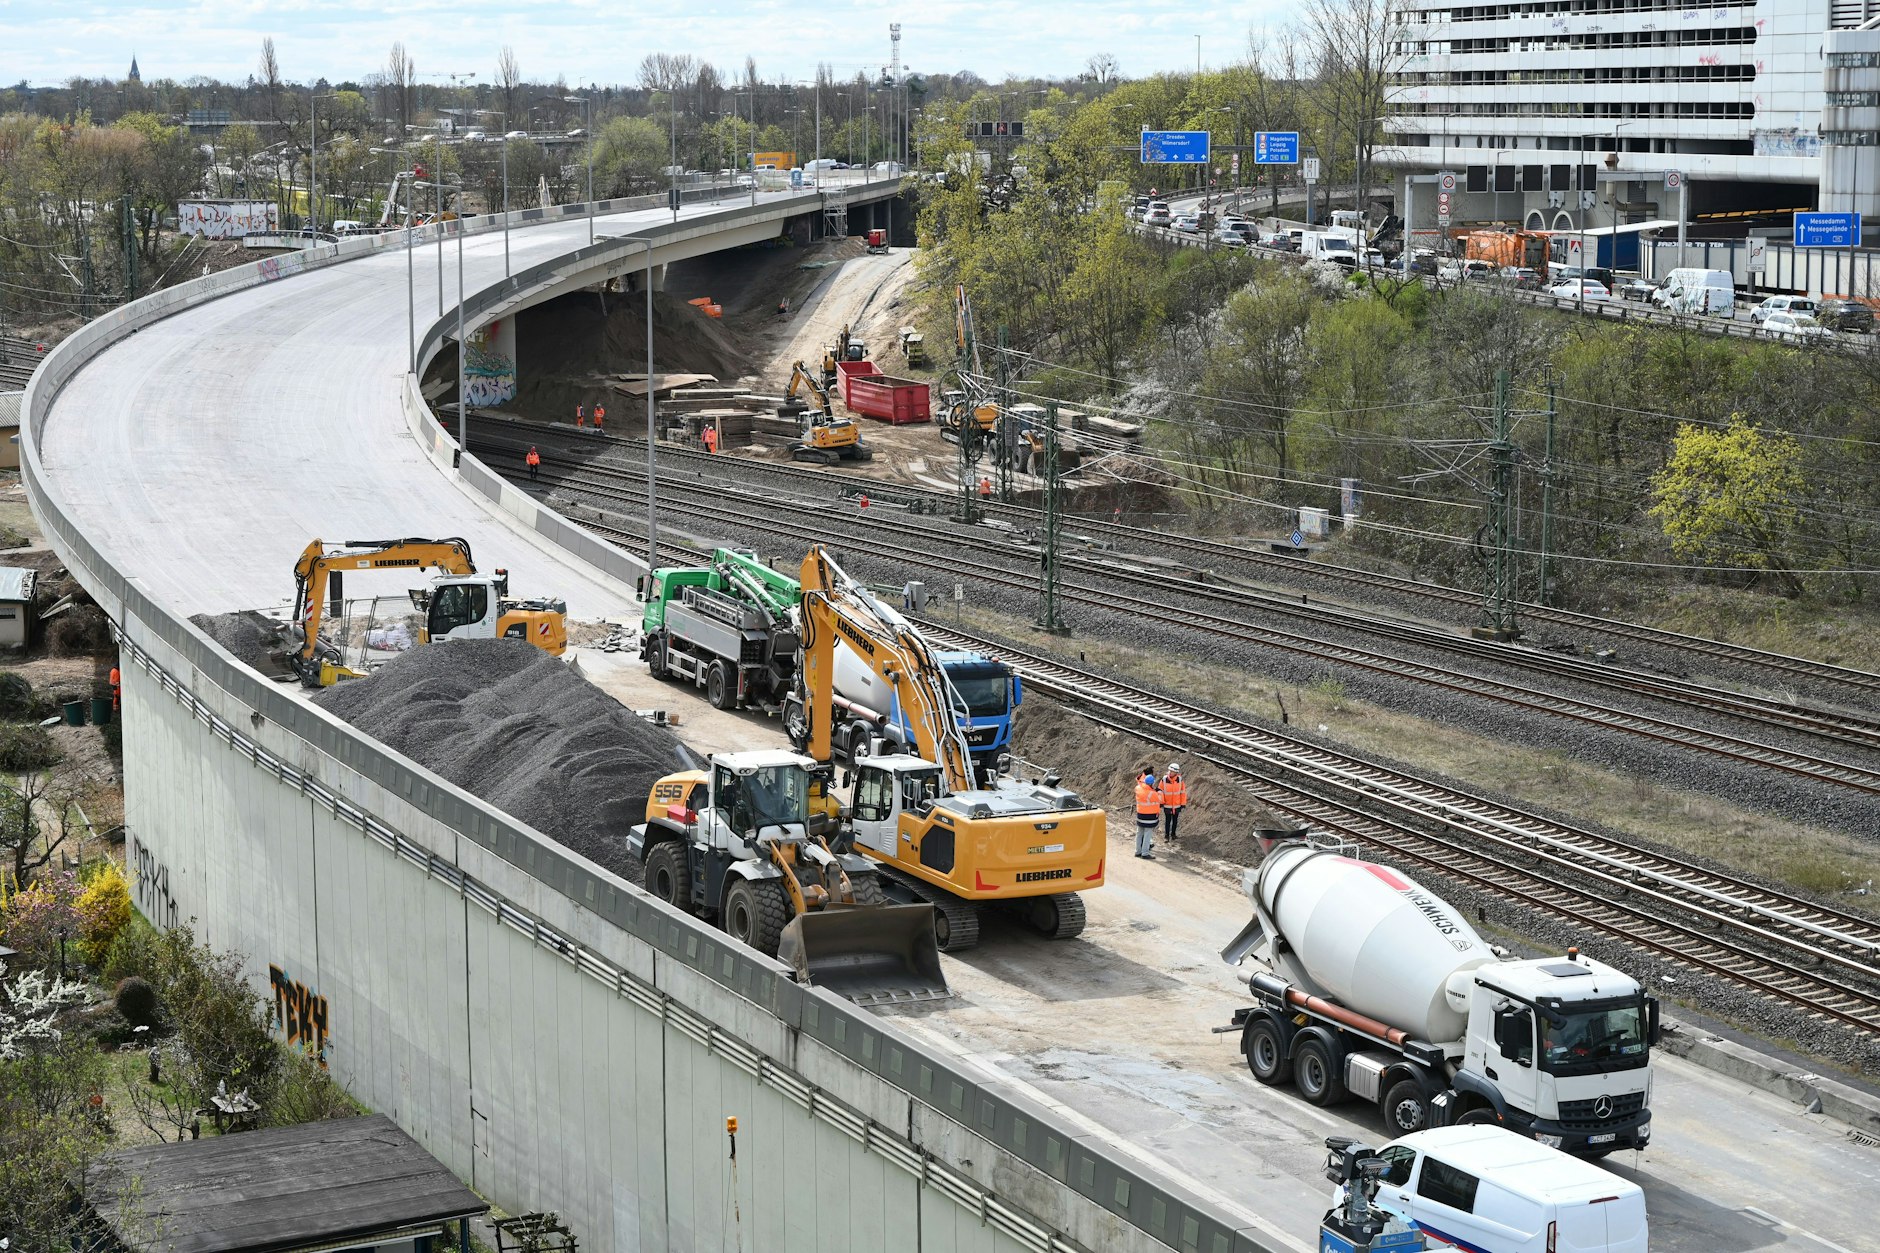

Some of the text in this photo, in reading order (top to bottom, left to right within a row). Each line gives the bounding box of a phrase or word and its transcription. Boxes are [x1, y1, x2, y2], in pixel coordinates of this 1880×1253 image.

[1807, 225, 1848, 233] Messegelände
[375, 559, 420, 567] LIEBHERR
[837, 617, 875, 657] LIEBHERR
[655, 784, 683, 798] 556
[1016, 868, 1072, 882] LIEBHERR
[1400, 889, 1460, 935] SCHWENK
